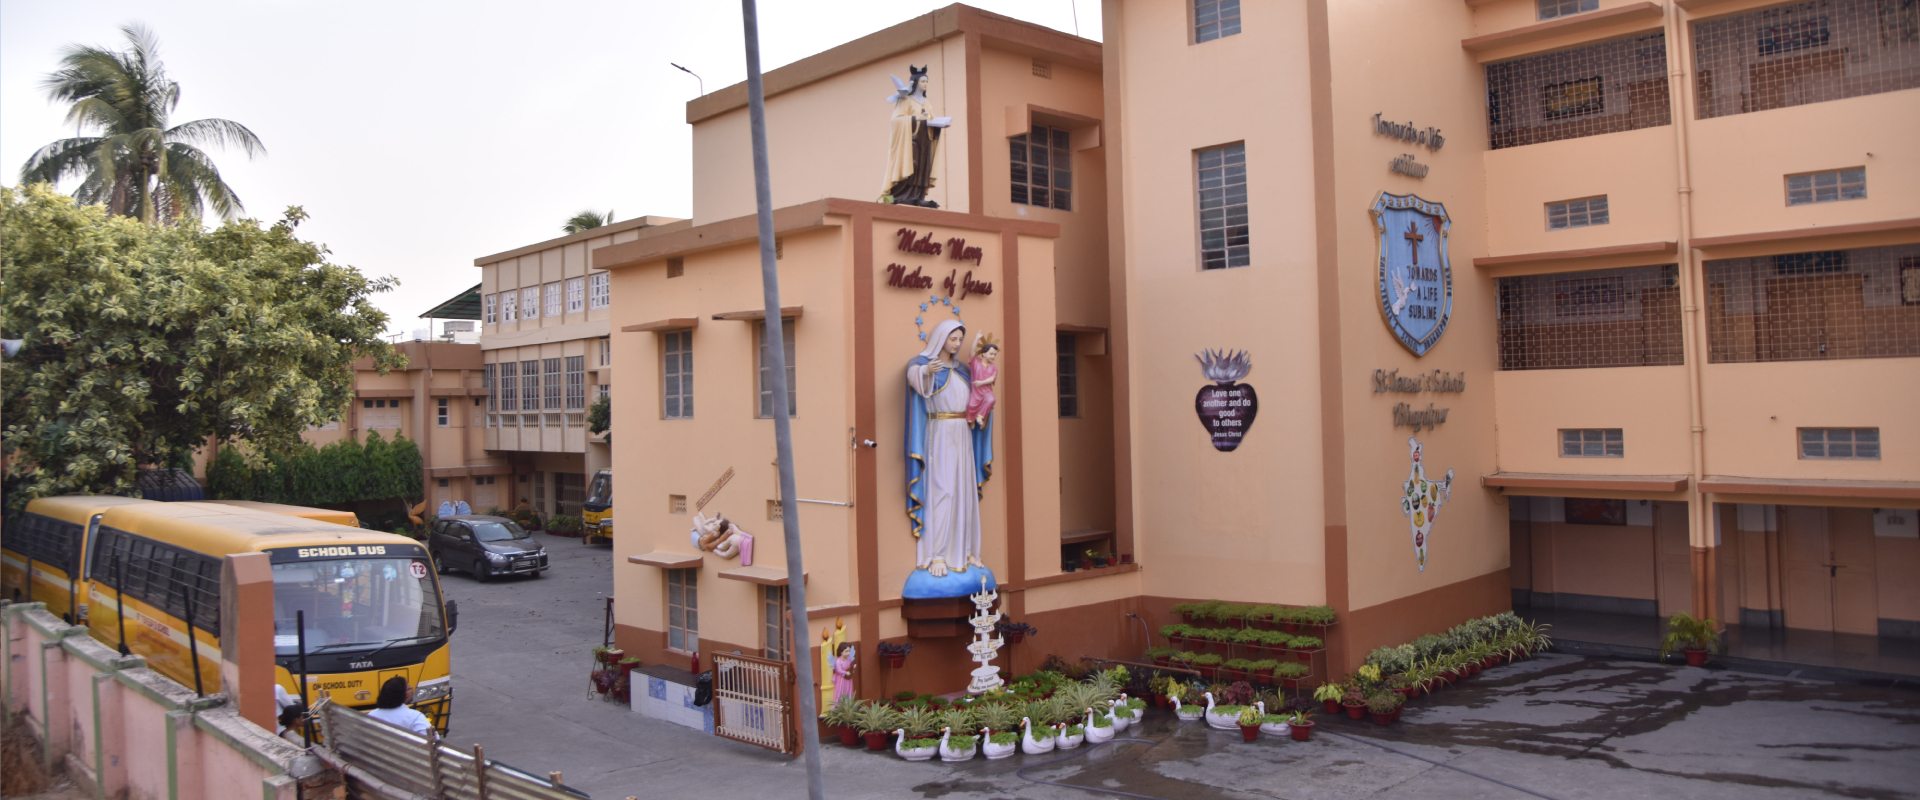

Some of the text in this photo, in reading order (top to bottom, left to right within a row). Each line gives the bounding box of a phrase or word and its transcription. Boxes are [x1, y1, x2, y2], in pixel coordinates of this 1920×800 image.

[1374, 111, 1445, 152] Towards a life
[897, 227, 983, 266] Mother Mary
[1406, 264, 1438, 282] TOWARDS
[887, 262, 993, 300] Mother of Jesus
[1416, 286, 1438, 301] A LIFE
[1408, 304, 1437, 320] SUBLIME
[1432, 368, 1466, 393] School
[1211, 389, 1242, 398] Love one
[1202, 398, 1251, 408] another and do
[1218, 408, 1236, 419] good
[1393, 401, 1450, 432] Bhagalpur
[1212, 418, 1242, 427] to others
[298, 545, 387, 558] SCHOOL BUS
[349, 661, 374, 669] TATA
[313, 680, 363, 691] ON SCHOOL DUTY
